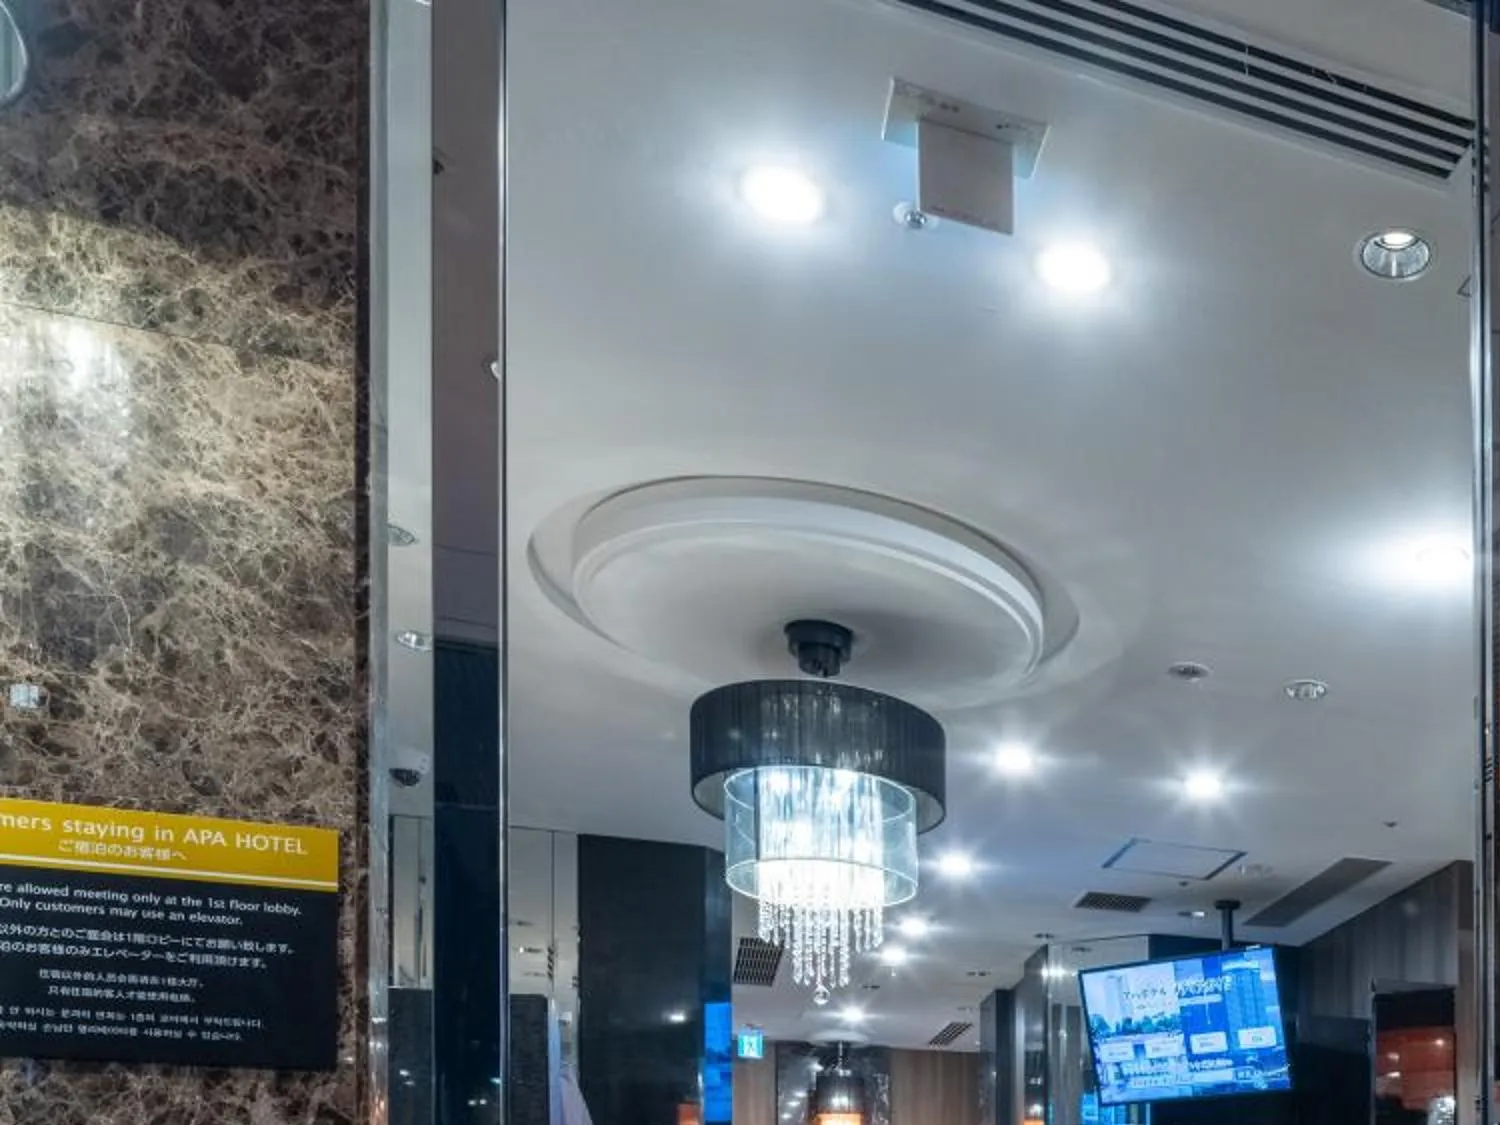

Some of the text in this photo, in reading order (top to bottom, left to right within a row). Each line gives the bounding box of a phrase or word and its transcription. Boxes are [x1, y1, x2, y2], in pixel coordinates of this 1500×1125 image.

[63, 819, 145, 843] staying
[155, 825, 175, 842] in
[183, 828, 228, 847] APA
[235, 831, 308, 855] HOTEL
[0, 897, 243, 926] Only customers may use an elevator.
[17, 883, 69, 898] allowed
[74, 889, 129, 903] meeting
[132, 892, 161, 905] only
[181, 896, 202, 908] the
[208, 897, 225, 909] 1st
[229, 899, 260, 912] floor
